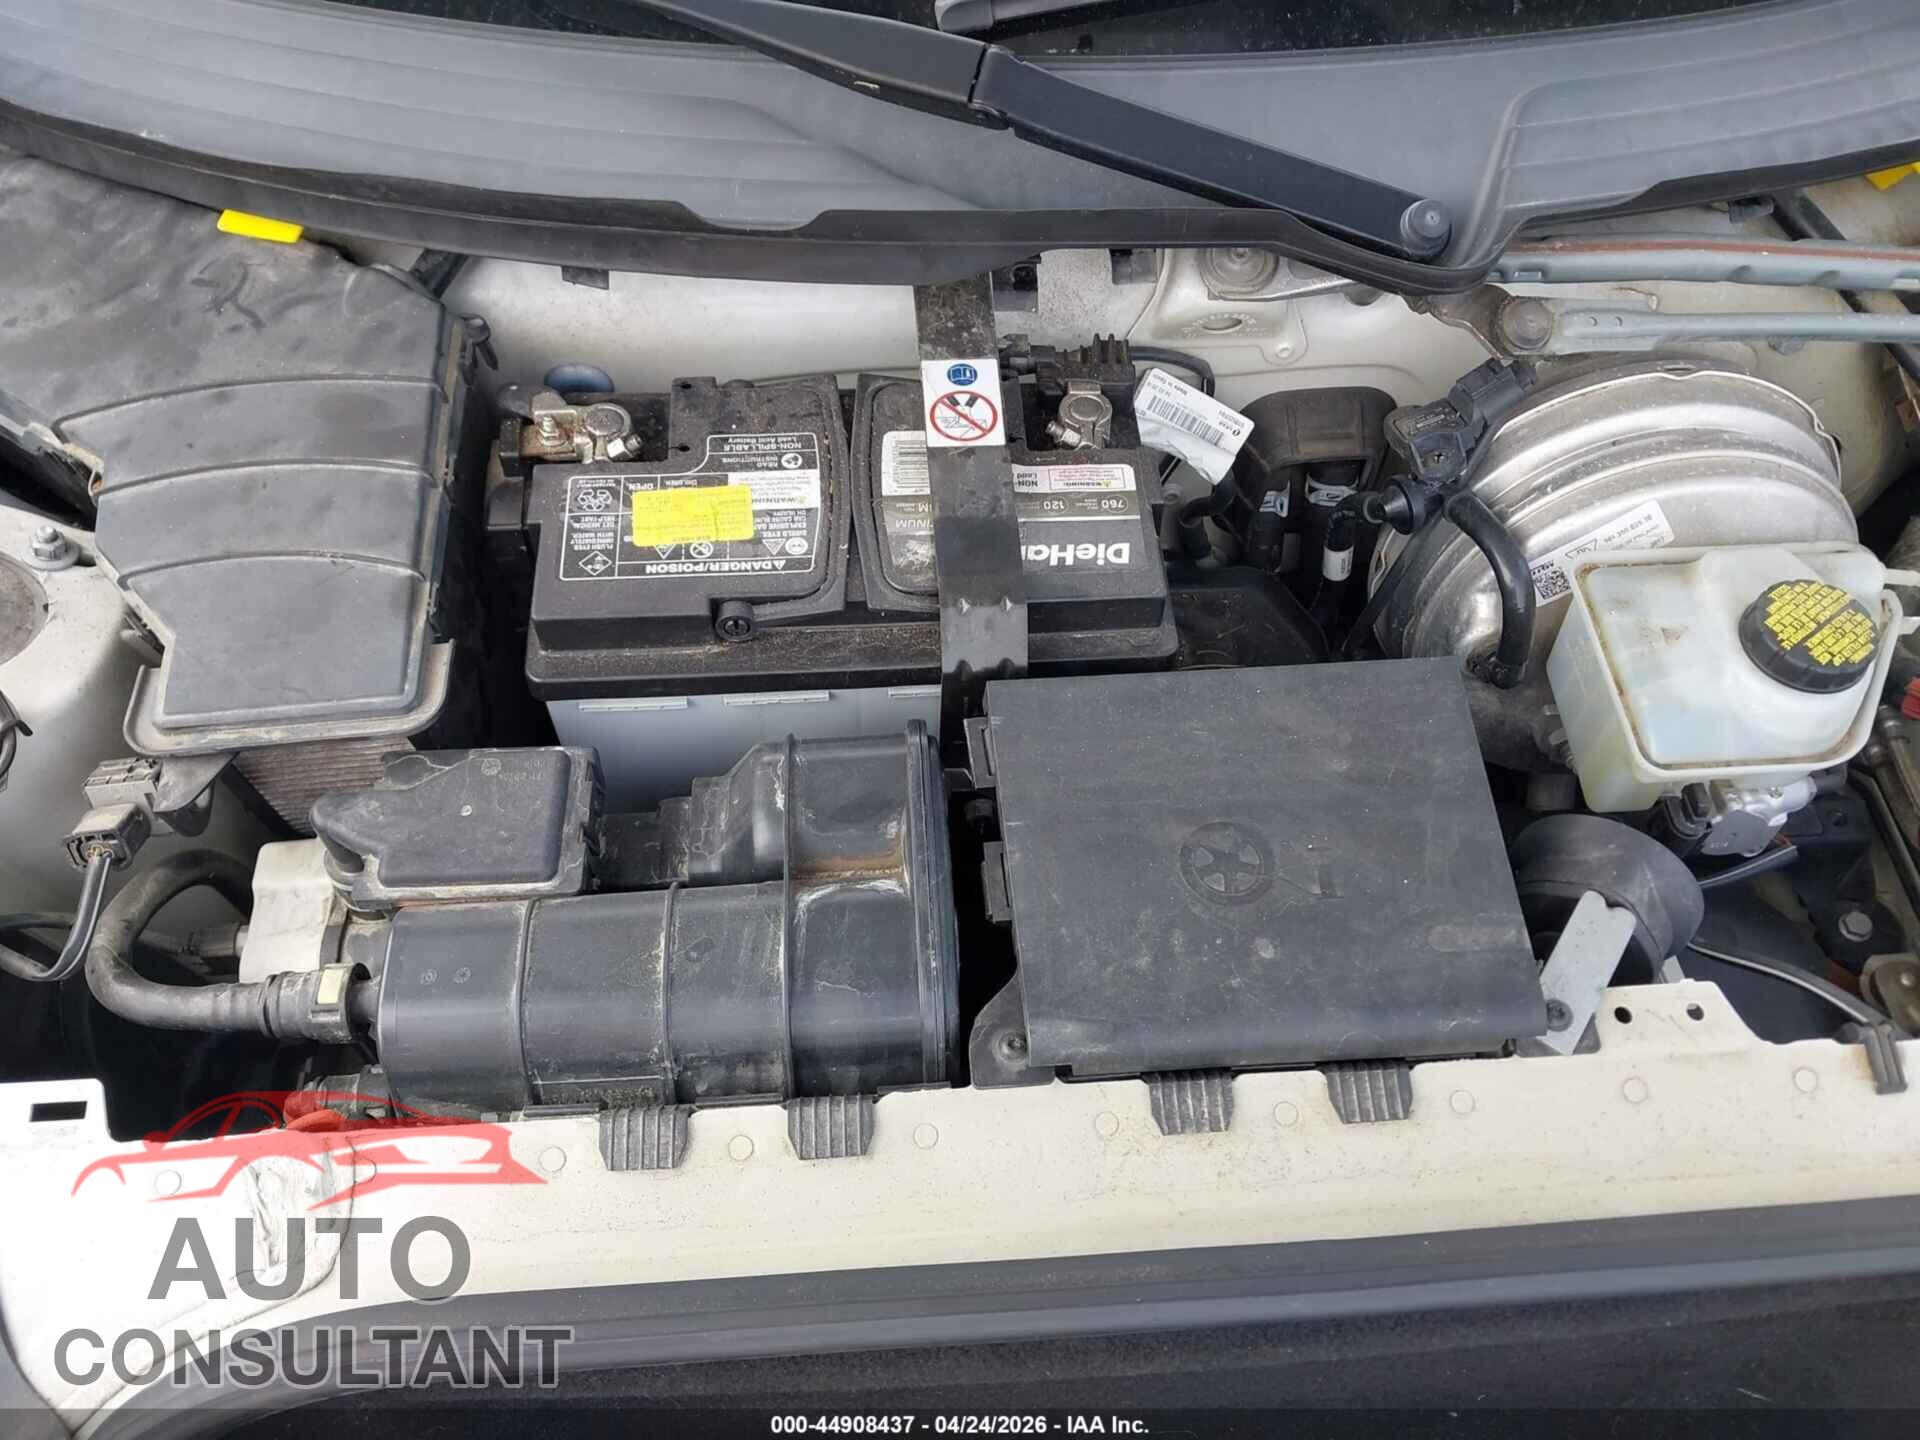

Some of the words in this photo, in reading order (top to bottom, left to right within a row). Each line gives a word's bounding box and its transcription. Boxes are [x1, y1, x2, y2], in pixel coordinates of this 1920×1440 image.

[723, 442, 802, 452] NON-SPILLABLE
[1043, 500, 1065, 510] 120
[1101, 499, 1125, 509] 760
[1021, 542, 1130, 566] DieHa
[646, 561, 772, 574] DANGER/POISON
